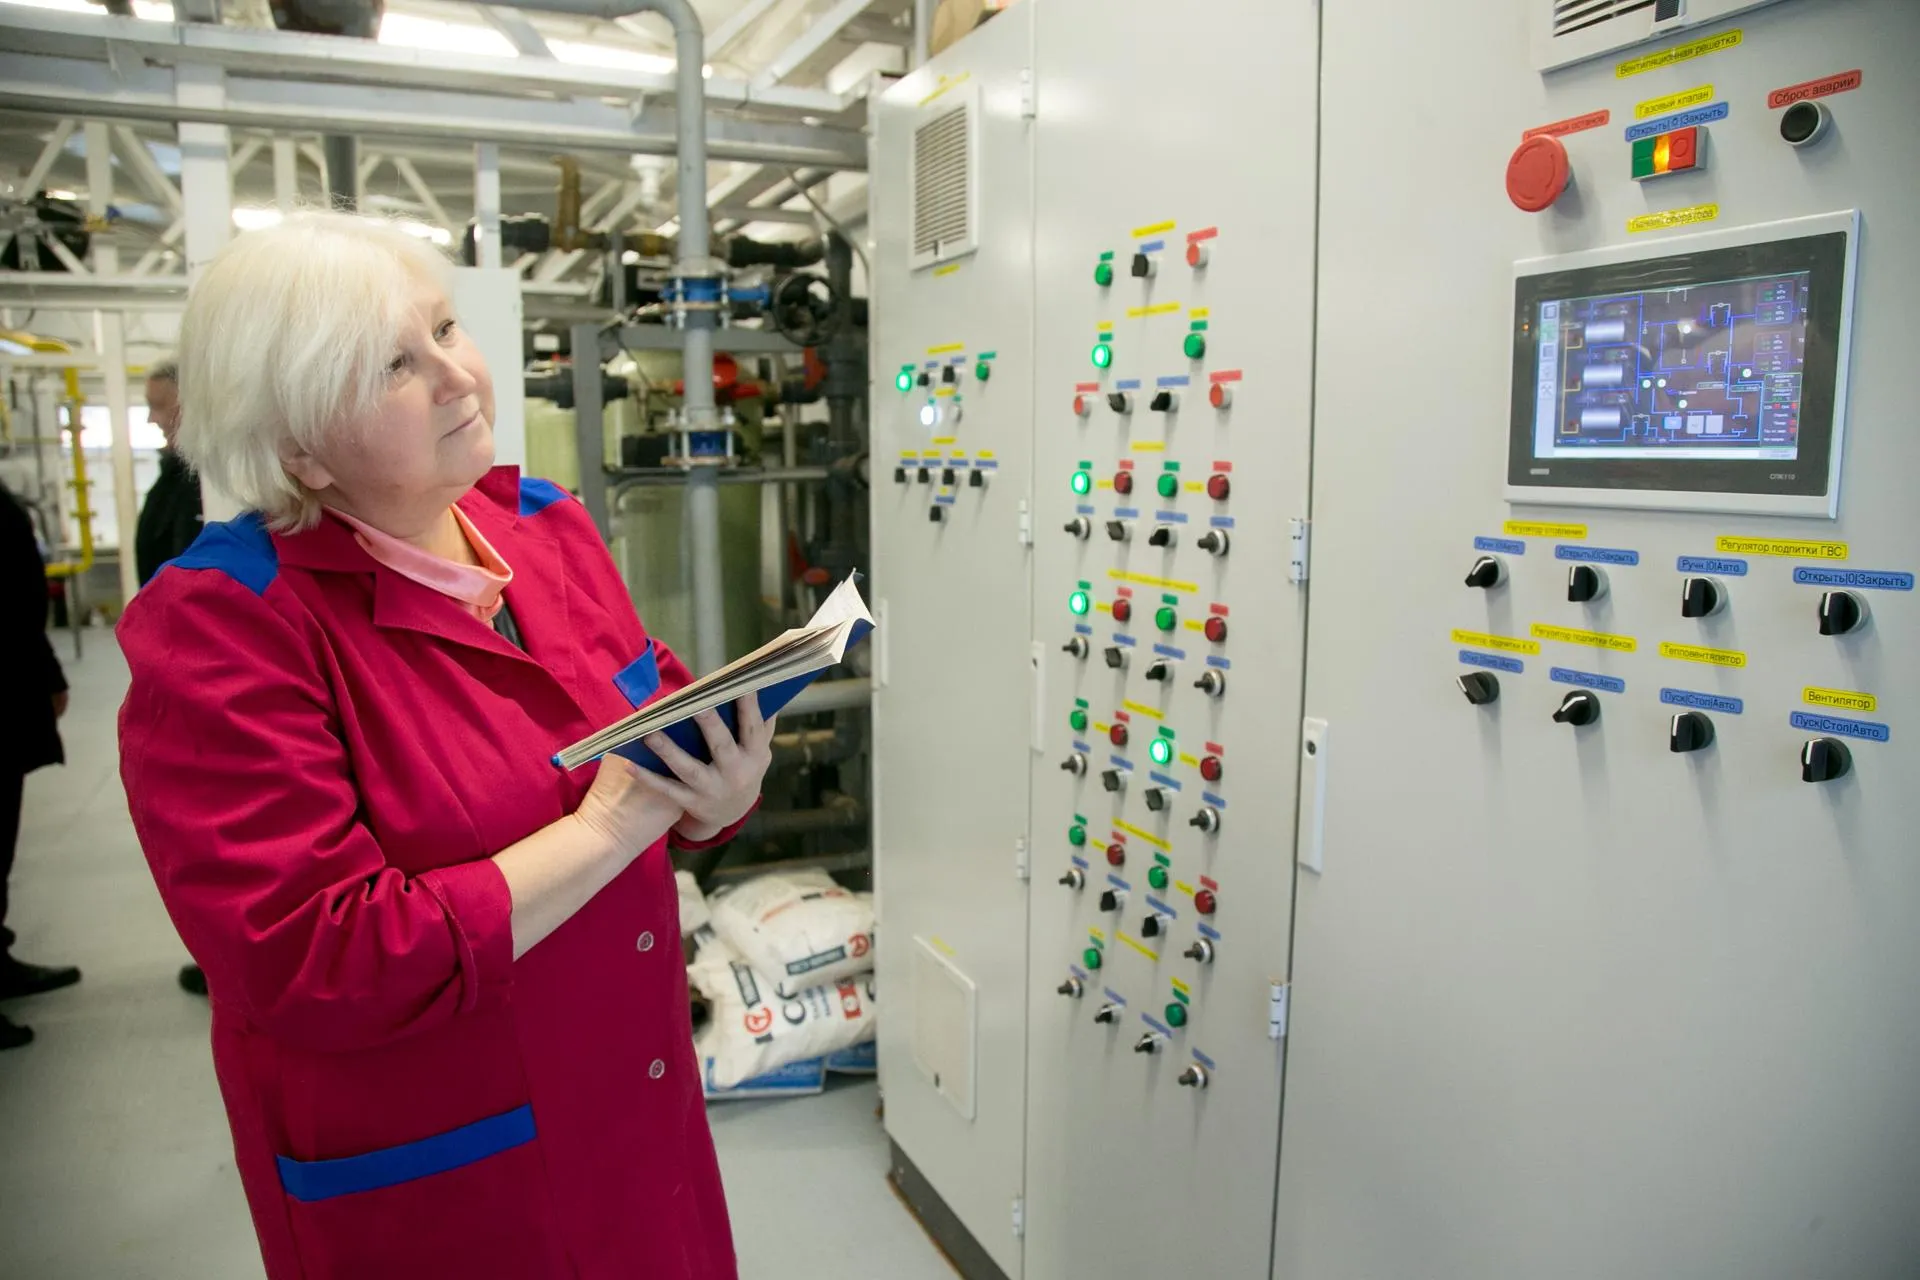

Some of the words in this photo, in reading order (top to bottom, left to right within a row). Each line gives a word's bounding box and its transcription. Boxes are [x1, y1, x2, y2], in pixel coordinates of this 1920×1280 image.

[1696, 35, 1737, 55] решетка
[1775, 89, 1809, 104] Сброс
[1812, 78, 1854, 95] аварии
[1639, 98, 1676, 116] Газовый
[1678, 91, 1709, 105] клапан
[1721, 539, 1769, 553] Регулятор
[1771, 544, 1817, 556] подпитки
[1820, 545, 1842, 557] ГВС
[1808, 691, 1871, 709] Вентилятор
